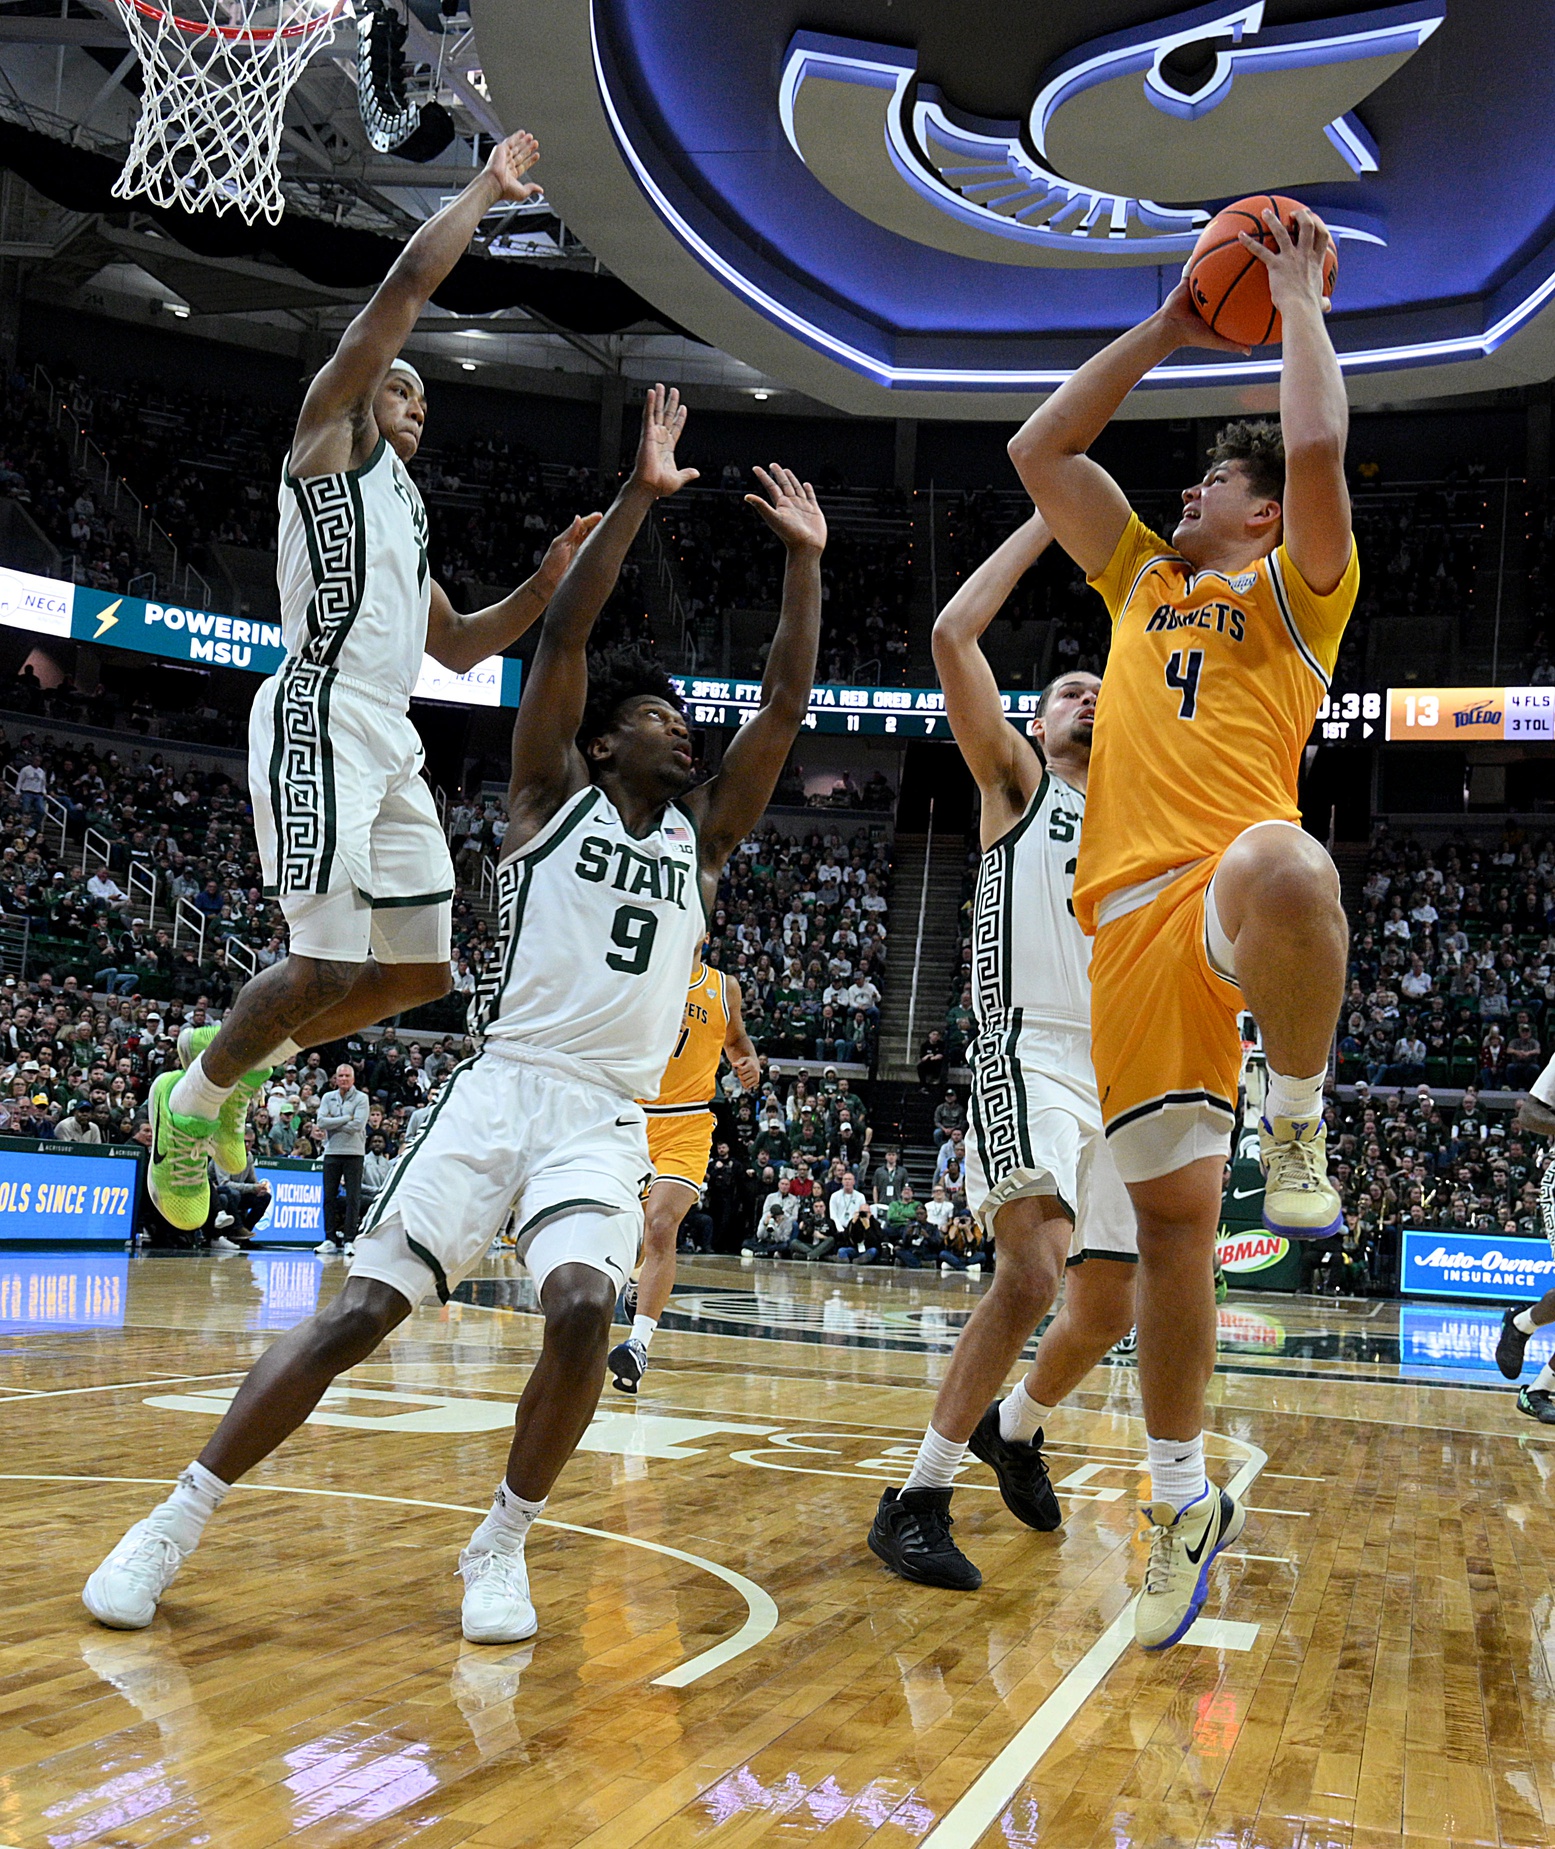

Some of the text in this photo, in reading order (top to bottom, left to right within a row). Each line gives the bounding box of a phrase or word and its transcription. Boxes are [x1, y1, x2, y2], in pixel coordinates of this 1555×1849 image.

[25, 595, 67, 614] NECA
[144, 603, 287, 648] POWERIN
[189, 637, 252, 668] MSU
[1164, 649, 1205, 721] 4
[839, 690, 869, 707] REB
[873, 691, 912, 709] OREB
[1512, 696, 1550, 707] 4 FLS
[695, 705, 726, 724] 57.1
[847, 715, 860, 731] 11
[885, 716, 897, 732] 2
[925, 718, 936, 734] 7
[1404, 695, 1440, 727] 13
[1452, 709, 1503, 728] TOLEDO
[1512, 719, 1550, 731] 3 TOL
[605, 904, 659, 975] 9
[35, 1183, 88, 1214] SINCE
[91, 1186, 129, 1215] 1972
[276, 1184, 322, 1203] MICHIGAN
[274, 1206, 320, 1228] LOTTERY
[1444, 1270, 1535, 1286] INSURANCE
